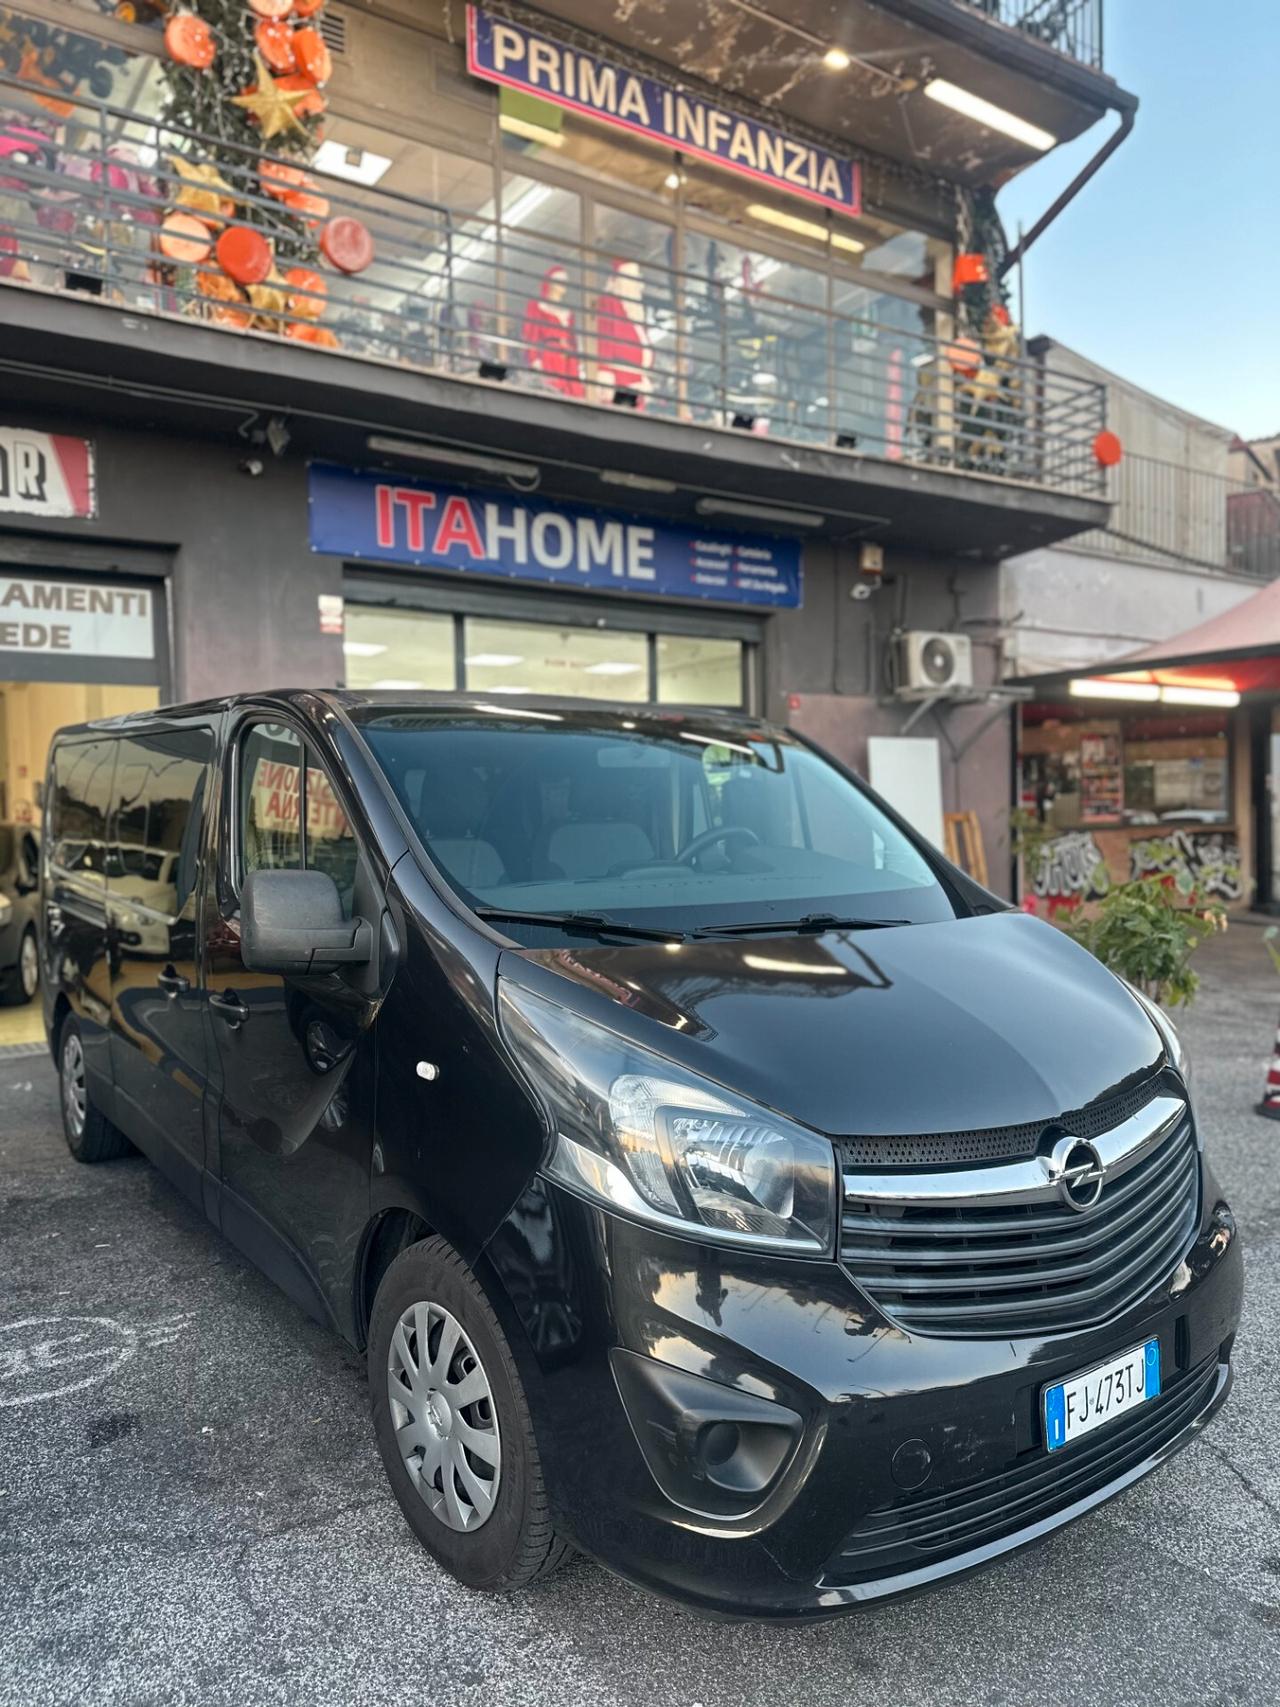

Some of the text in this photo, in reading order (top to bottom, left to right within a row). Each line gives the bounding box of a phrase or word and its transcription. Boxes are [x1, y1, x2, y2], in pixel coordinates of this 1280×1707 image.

[492, 24, 845, 201] PRIMA INFANZIA
[0, 438, 48, 503] R
[374, 483, 657, 581] ITAHOME
